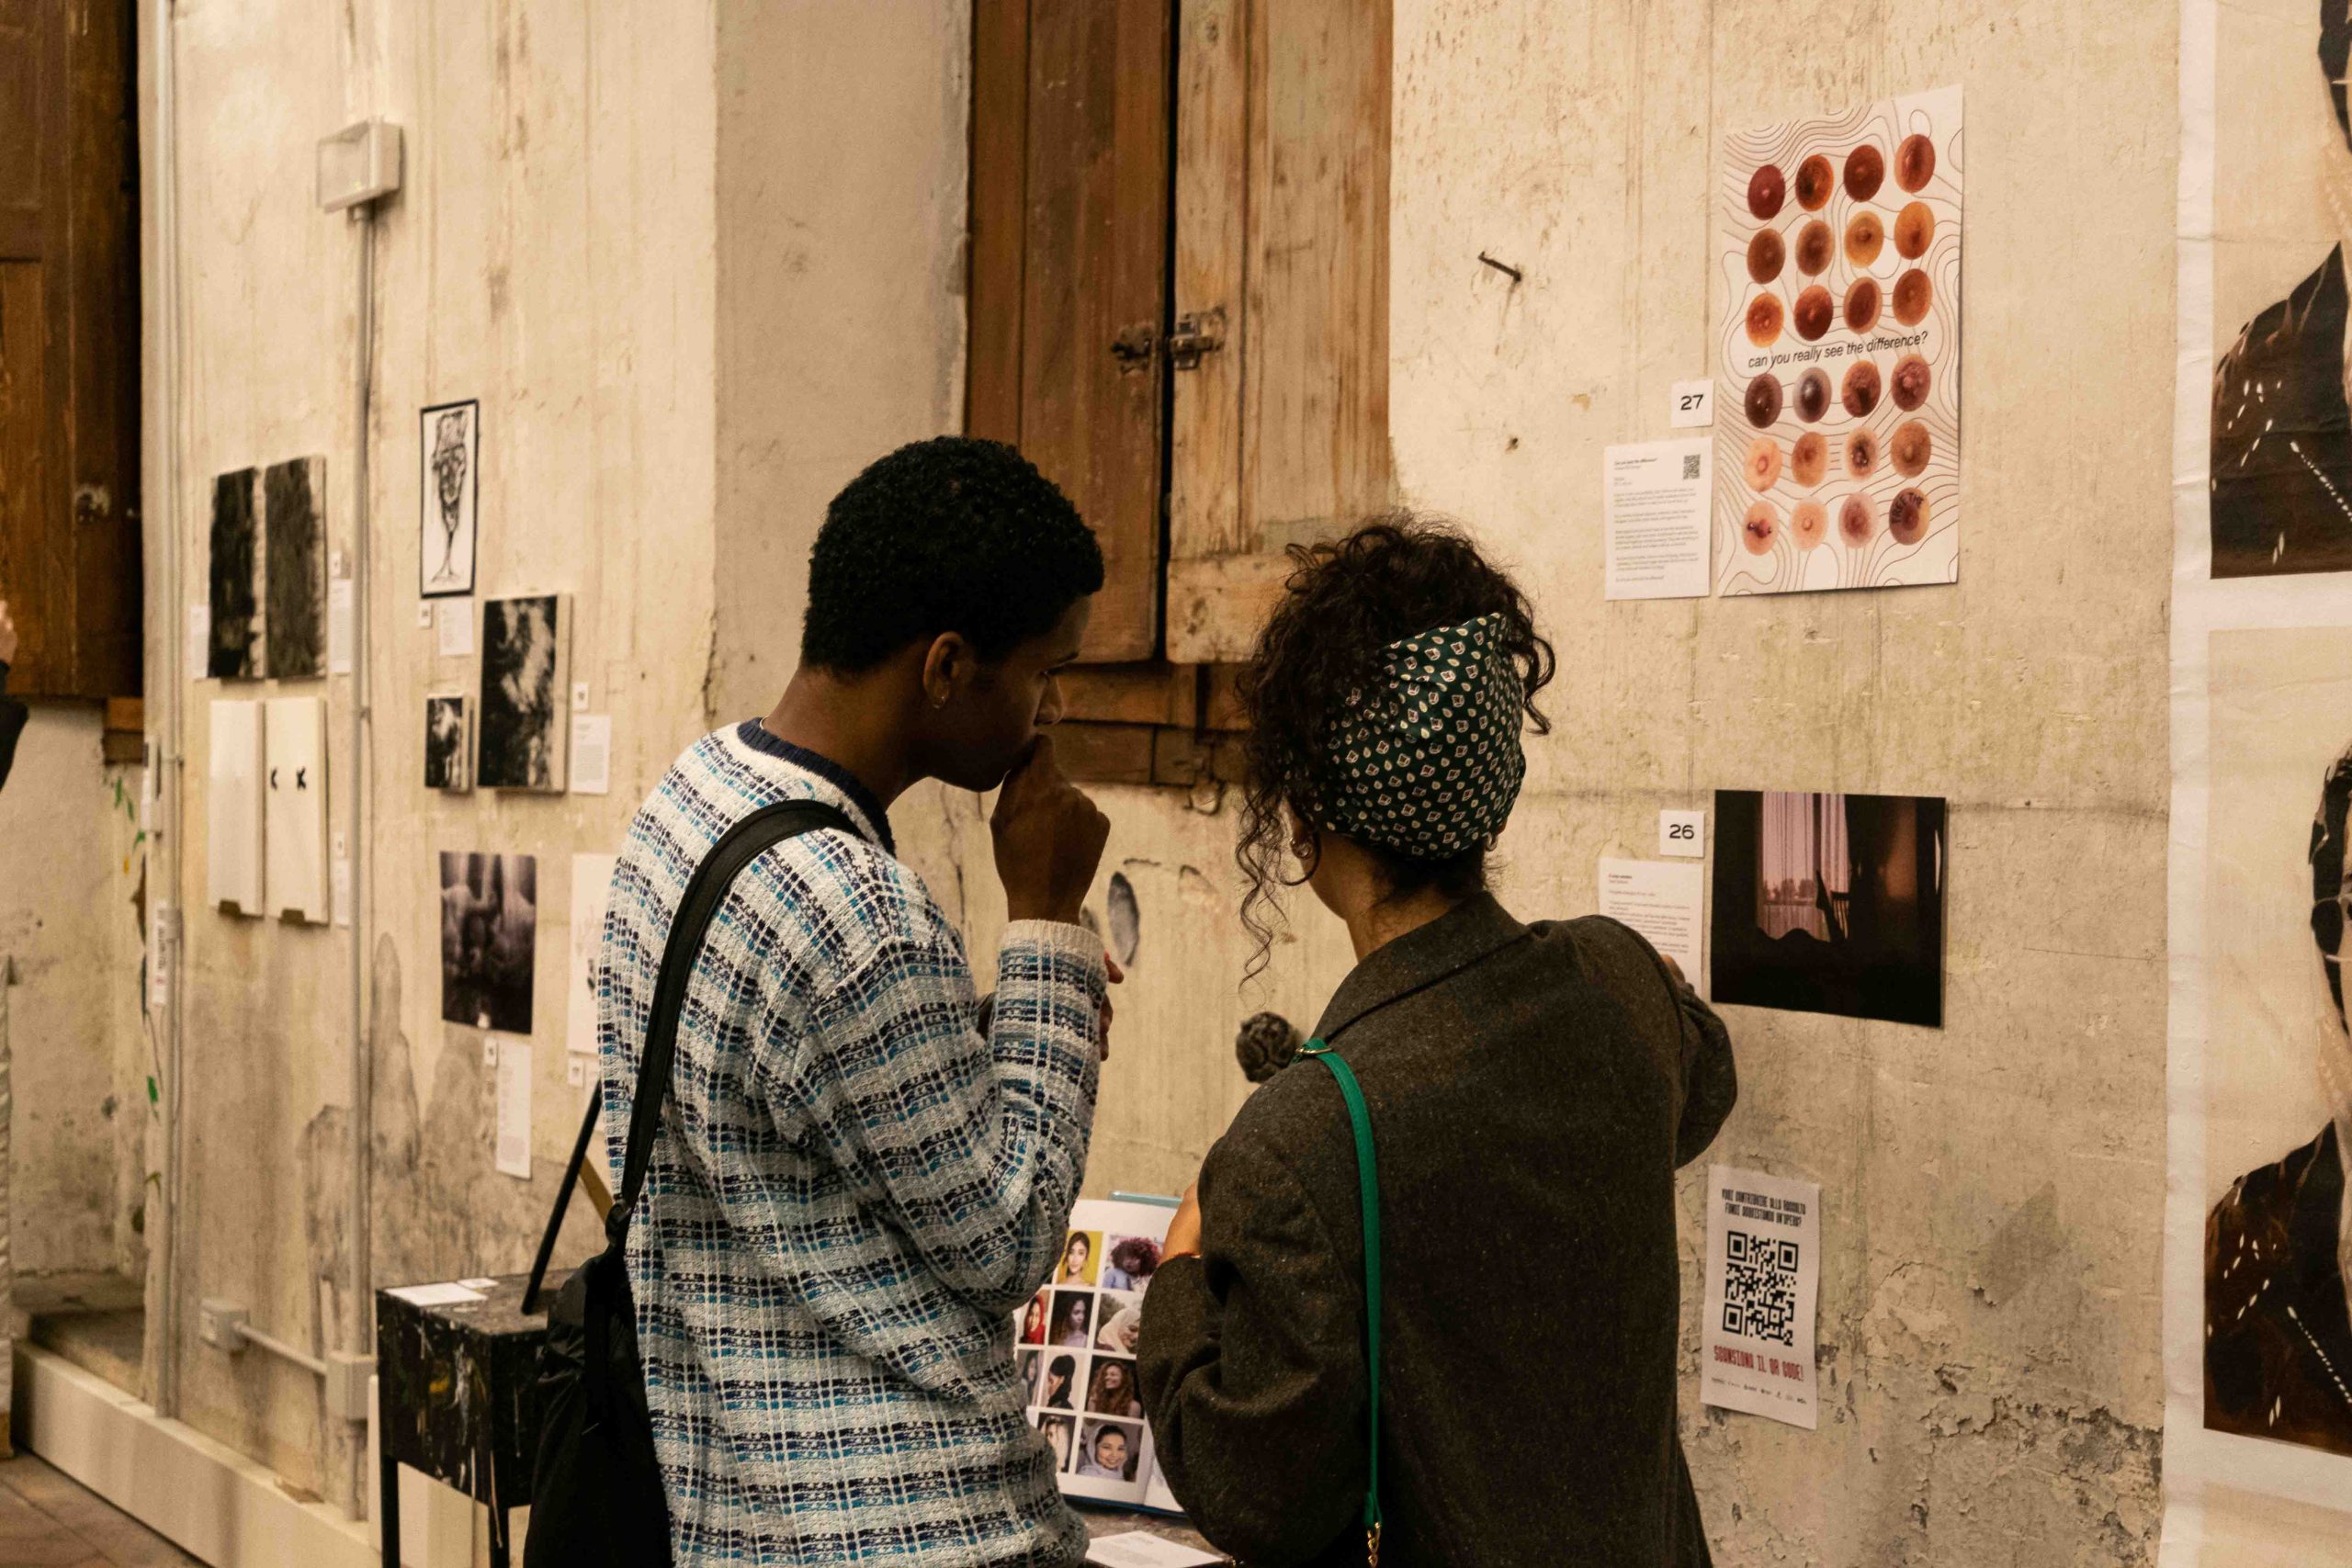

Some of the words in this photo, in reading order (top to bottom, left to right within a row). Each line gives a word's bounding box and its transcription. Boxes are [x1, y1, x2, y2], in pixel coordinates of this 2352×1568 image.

[1748, 355, 1768, 368] can
[1770, 351, 1791, 369] you
[1793, 344, 1822, 365] really
[1825, 343, 1843, 357] see
[1846, 337, 1863, 354] the
[1866, 331, 1928, 352] difference?
[1680, 394, 1703, 411] 27
[1669, 824, 1694, 840] 26
[1757, 1355, 1767, 1372] IL
[1770, 1358, 1780, 1376] QR
[1782, 1361, 1804, 1382] CODE!
